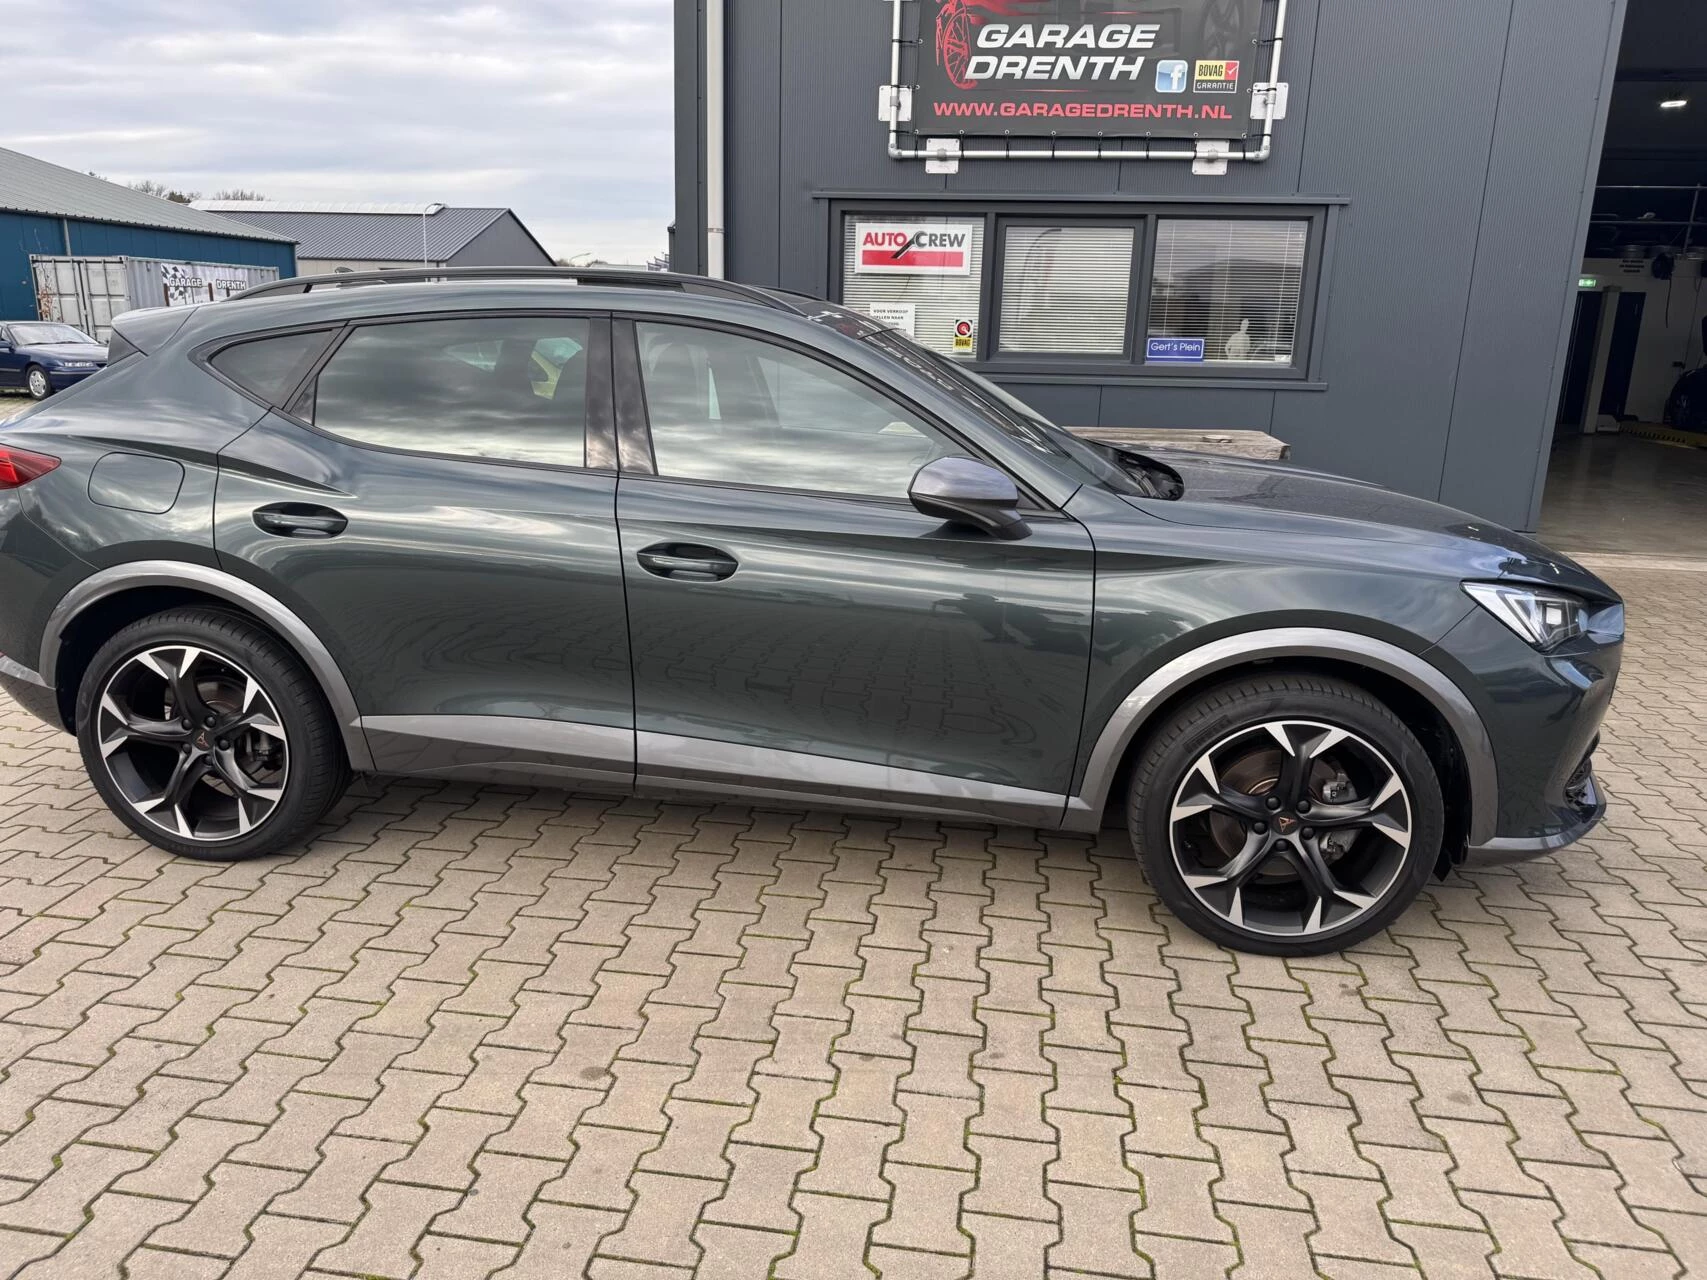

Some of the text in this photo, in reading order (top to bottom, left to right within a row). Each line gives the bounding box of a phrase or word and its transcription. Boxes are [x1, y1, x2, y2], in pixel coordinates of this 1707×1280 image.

[976, 24, 1161, 49] GARAGE
[965, 56, 1145, 81] DRENTH
[1198, 65, 1223, 76] BOVAG
[933, 102, 1233, 120] WWW.GARAGEDRENTH.NL
[863, 230, 966, 248] AUTO CREW
[169, 277, 246, 290] GARAGE DRENTH
[955, 338, 971, 347] BOVAG
[1151, 343, 1200, 351] Gert's Plein
